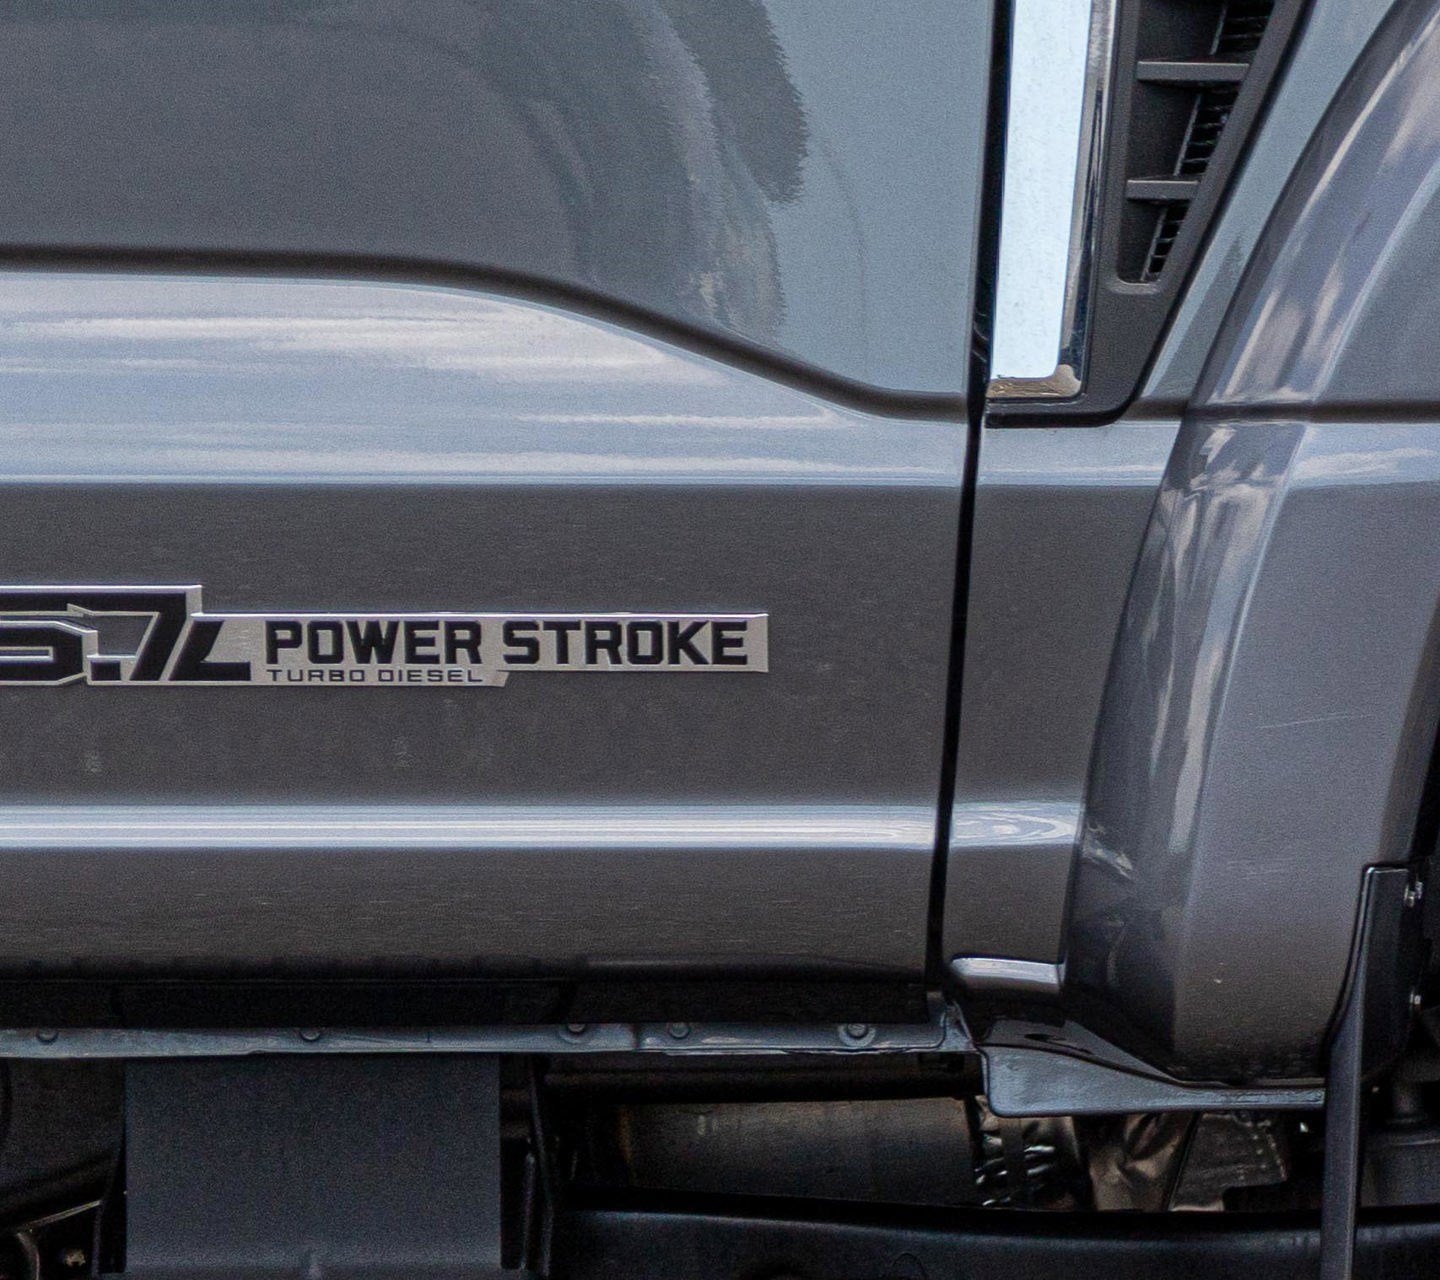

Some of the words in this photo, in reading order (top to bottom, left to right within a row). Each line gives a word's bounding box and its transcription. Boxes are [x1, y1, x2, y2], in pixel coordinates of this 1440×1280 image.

[265, 620, 483, 666] POWER
[502, 620, 749, 666] STROKE
[266, 669, 366, 683] TURBO
[377, 669, 484, 683] DIESEL
